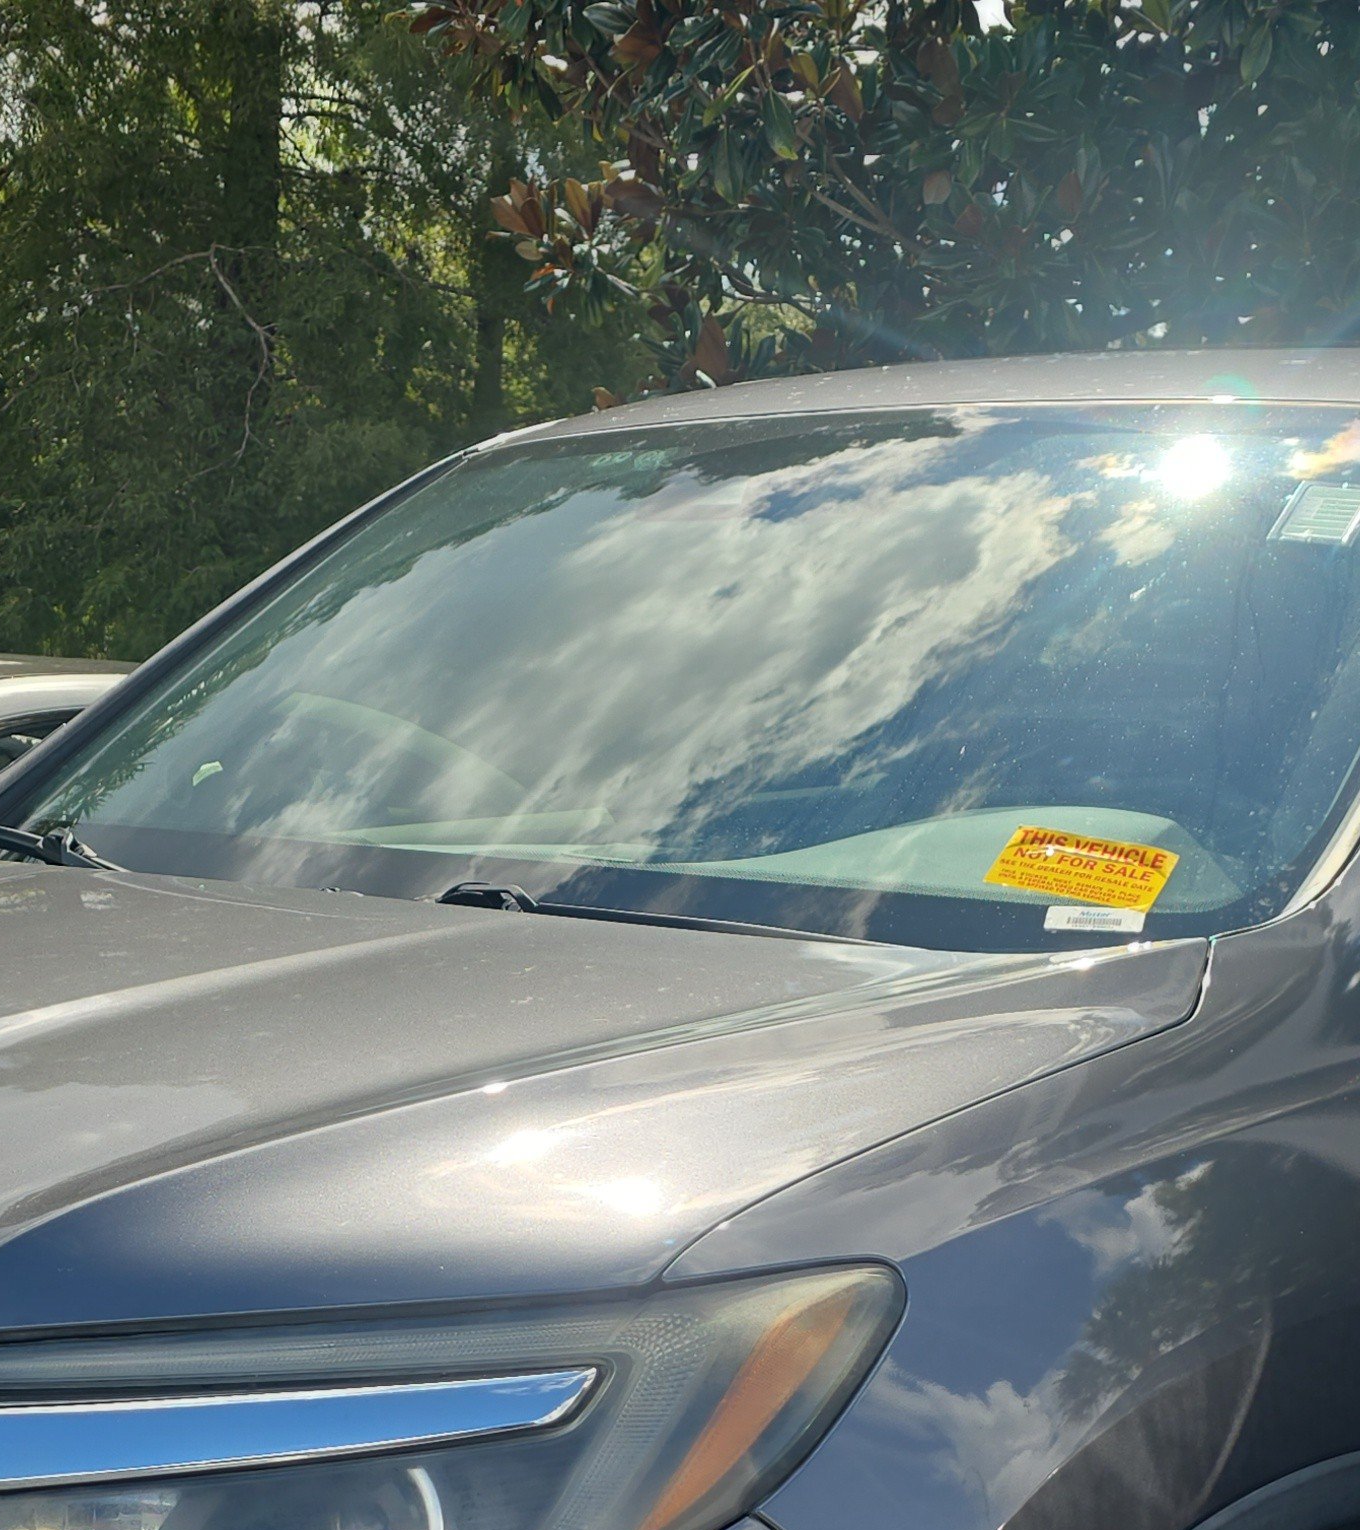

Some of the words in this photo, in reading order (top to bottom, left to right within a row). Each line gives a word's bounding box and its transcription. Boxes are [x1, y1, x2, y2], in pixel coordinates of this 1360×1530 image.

[1021, 830, 1070, 846] THIS
[1076, 839, 1168, 869] VEHICLE
[1038, 865, 1072, 875] DEALER
[1094, 876, 1130, 887] RESALE
[1131, 883, 1154, 892] DATE
[1057, 856, 1099, 871] FOR
[1101, 864, 1156, 882] SALE
